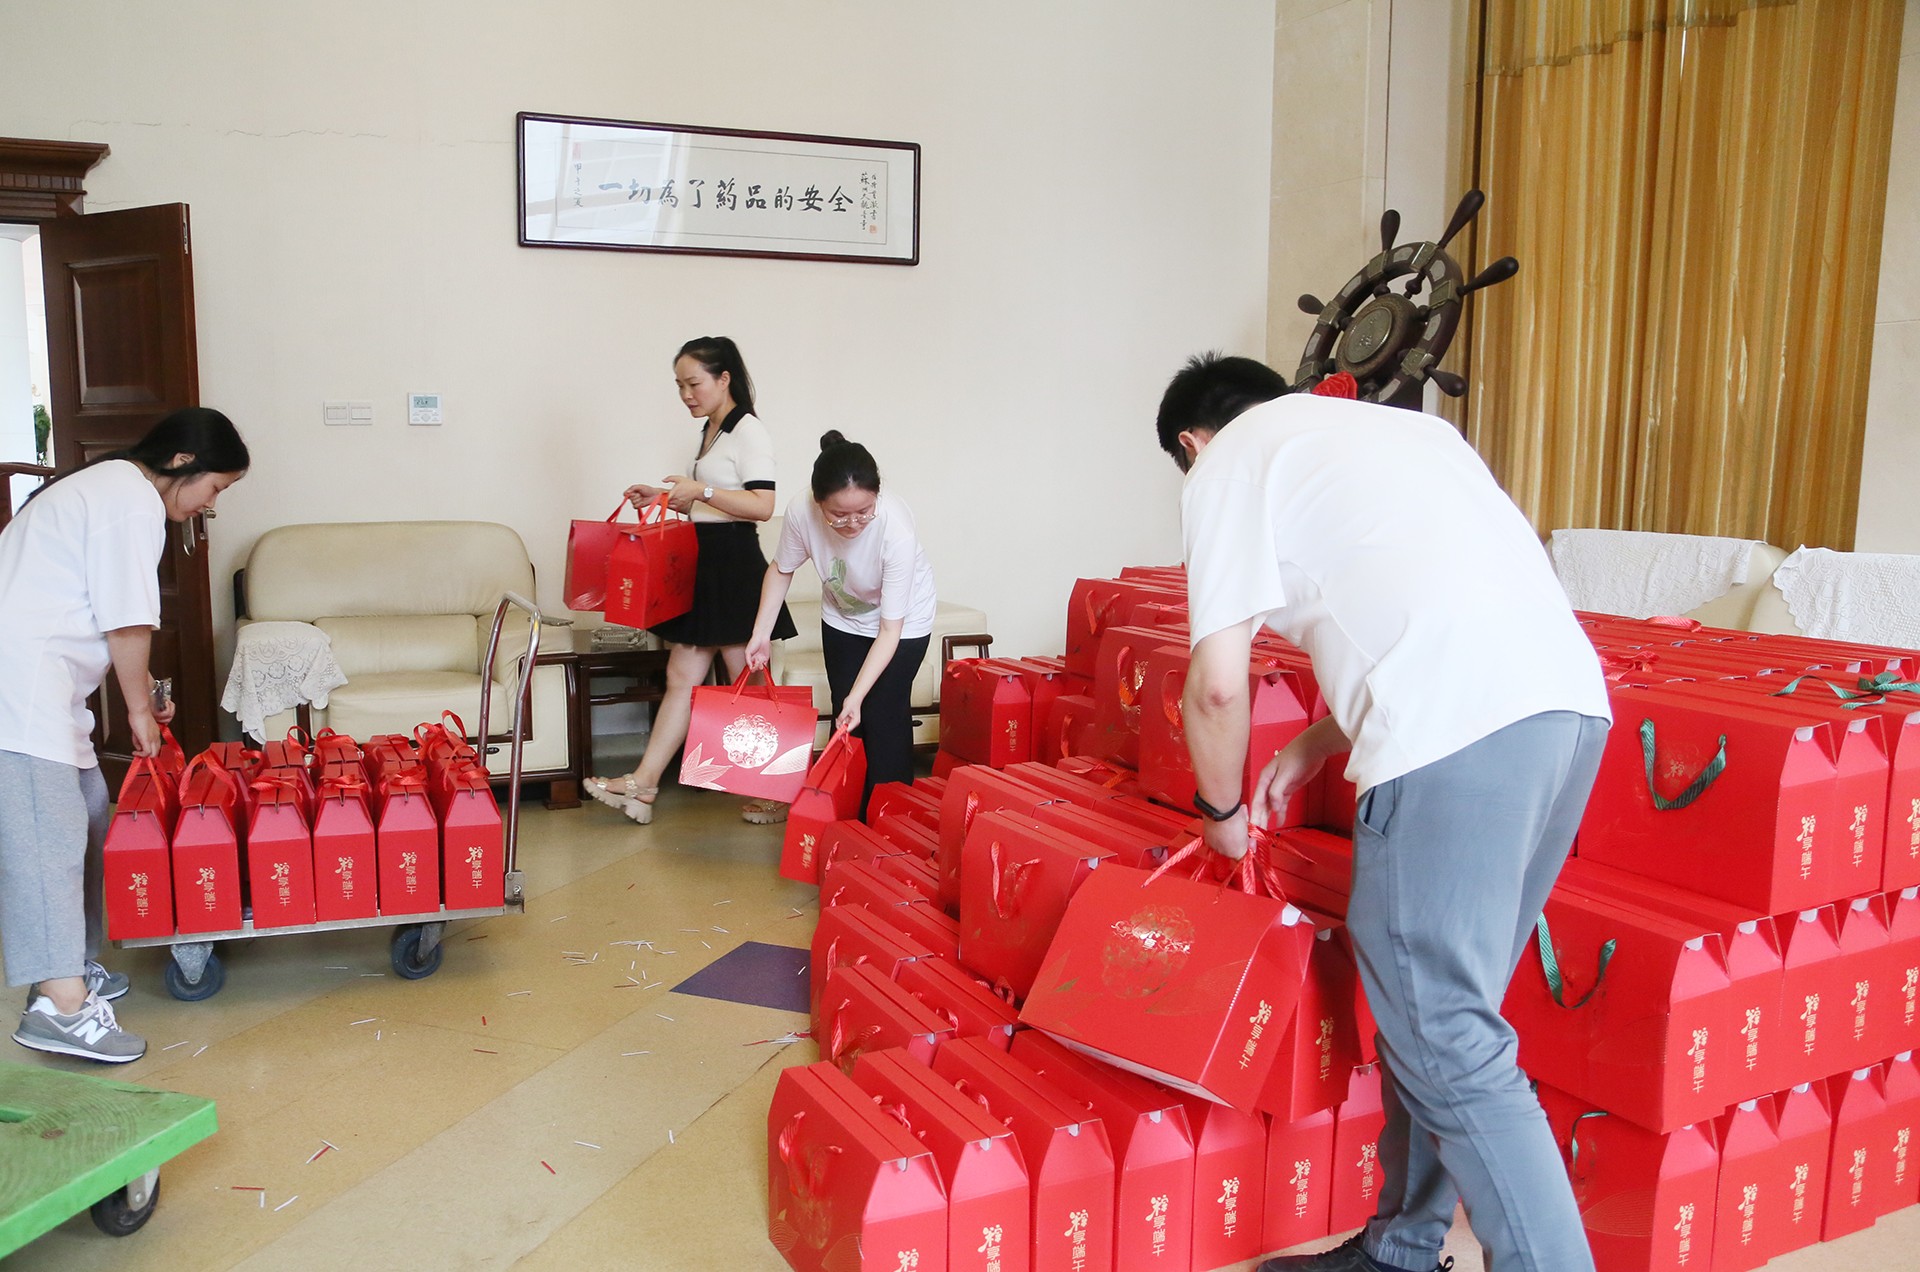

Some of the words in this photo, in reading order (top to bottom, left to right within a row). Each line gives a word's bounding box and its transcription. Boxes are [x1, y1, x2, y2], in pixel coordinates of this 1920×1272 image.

[1795, 814, 1817, 880] 粽享端午
[1848, 804, 1868, 867] 粽享端午
[1799, 993, 1820, 1056] 粽享端午
[1850, 979, 1870, 1041] 粽享端午
[1901, 966, 1920, 1026] 粽享端午
[73, 1018, 110, 1045] N
[1238, 999, 1272, 1070] 粽享端午
[1687, 1027, 1709, 1094] 粽享端午
[1740, 1006, 1761, 1071] 粽享端午
[1289, 1158, 1312, 1219] 粽享端午
[1356, 1142, 1377, 1200] 粽享端午
[1145, 1194, 1169, 1257] 粽享端午
[1216, 1176, 1240, 1238] 粽享端午
[1064, 1210, 1088, 1272] 粽享端午
